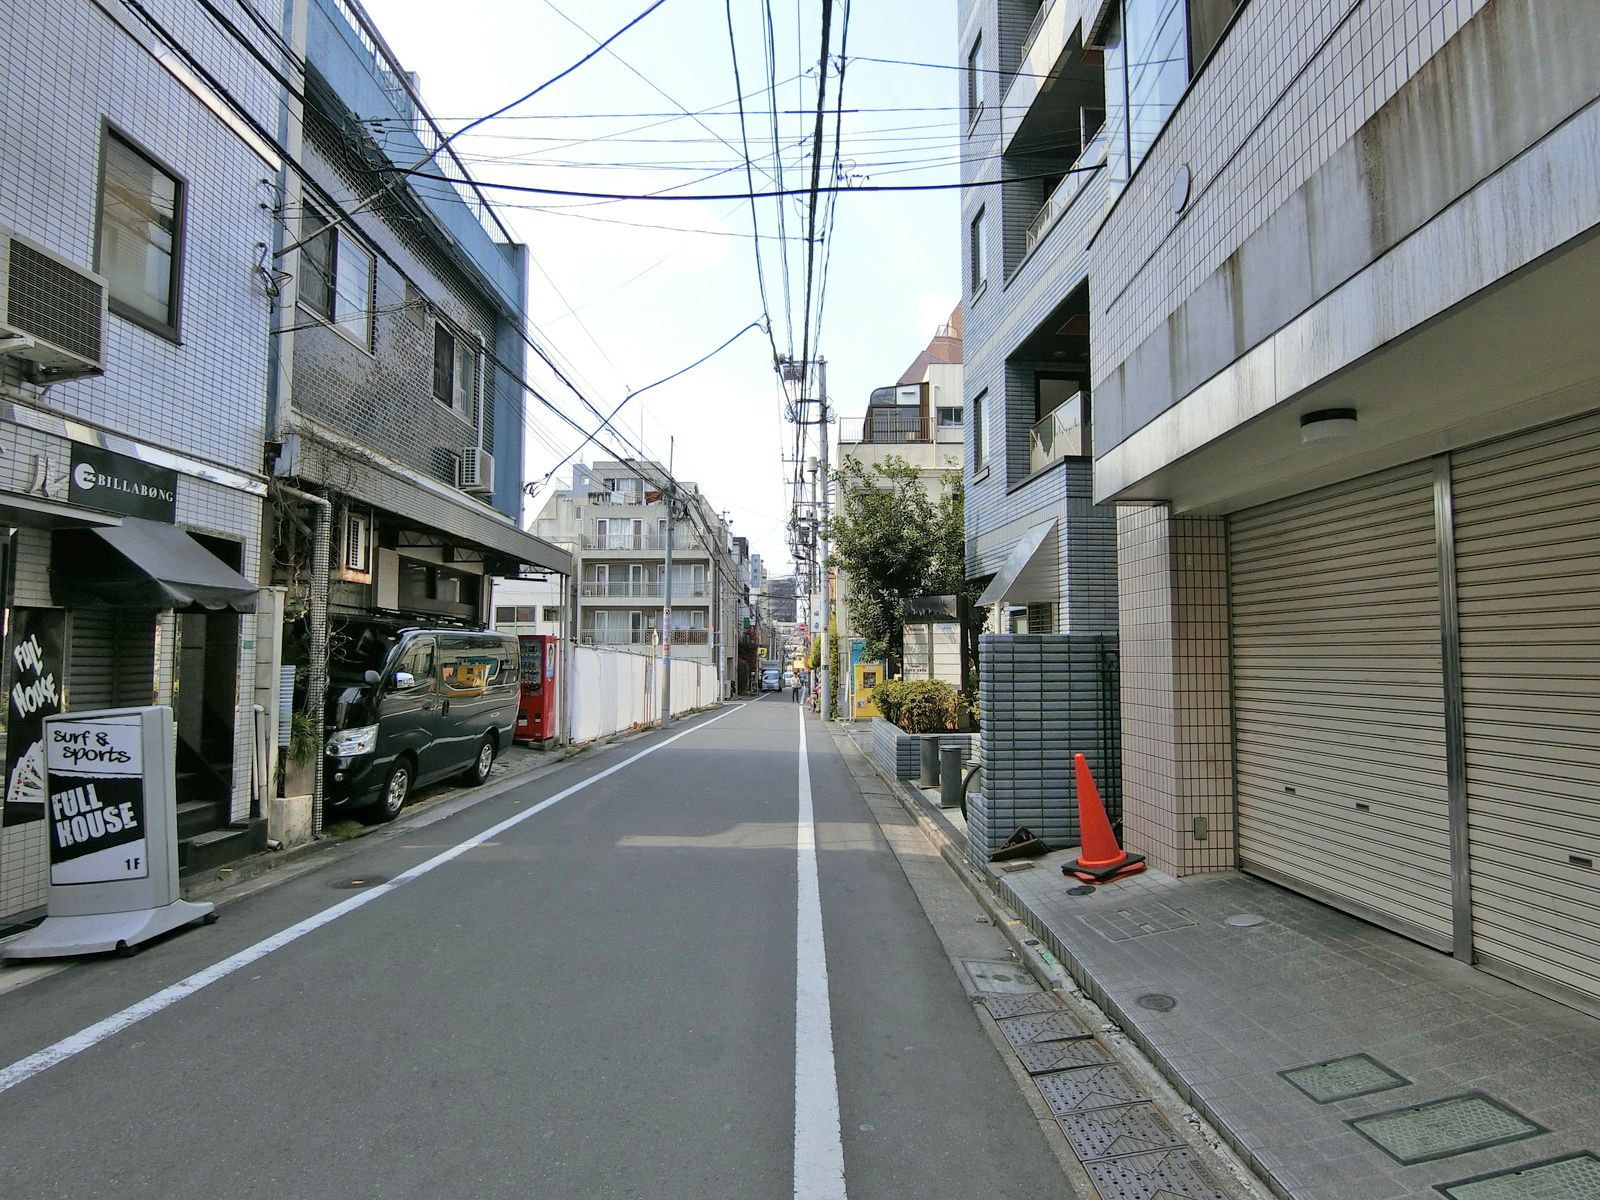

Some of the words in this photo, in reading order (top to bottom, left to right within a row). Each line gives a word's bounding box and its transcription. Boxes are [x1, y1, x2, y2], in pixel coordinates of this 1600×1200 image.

[13, 633, 43, 676] FULL
[12, 673, 59, 719] HOUSE
[53, 730, 90, 746] surf
[96, 731, 110, 746] &
[62, 746, 132, 765] sports
[51, 783, 103, 821] FULL
[56, 801, 138, 848] HOUSE
